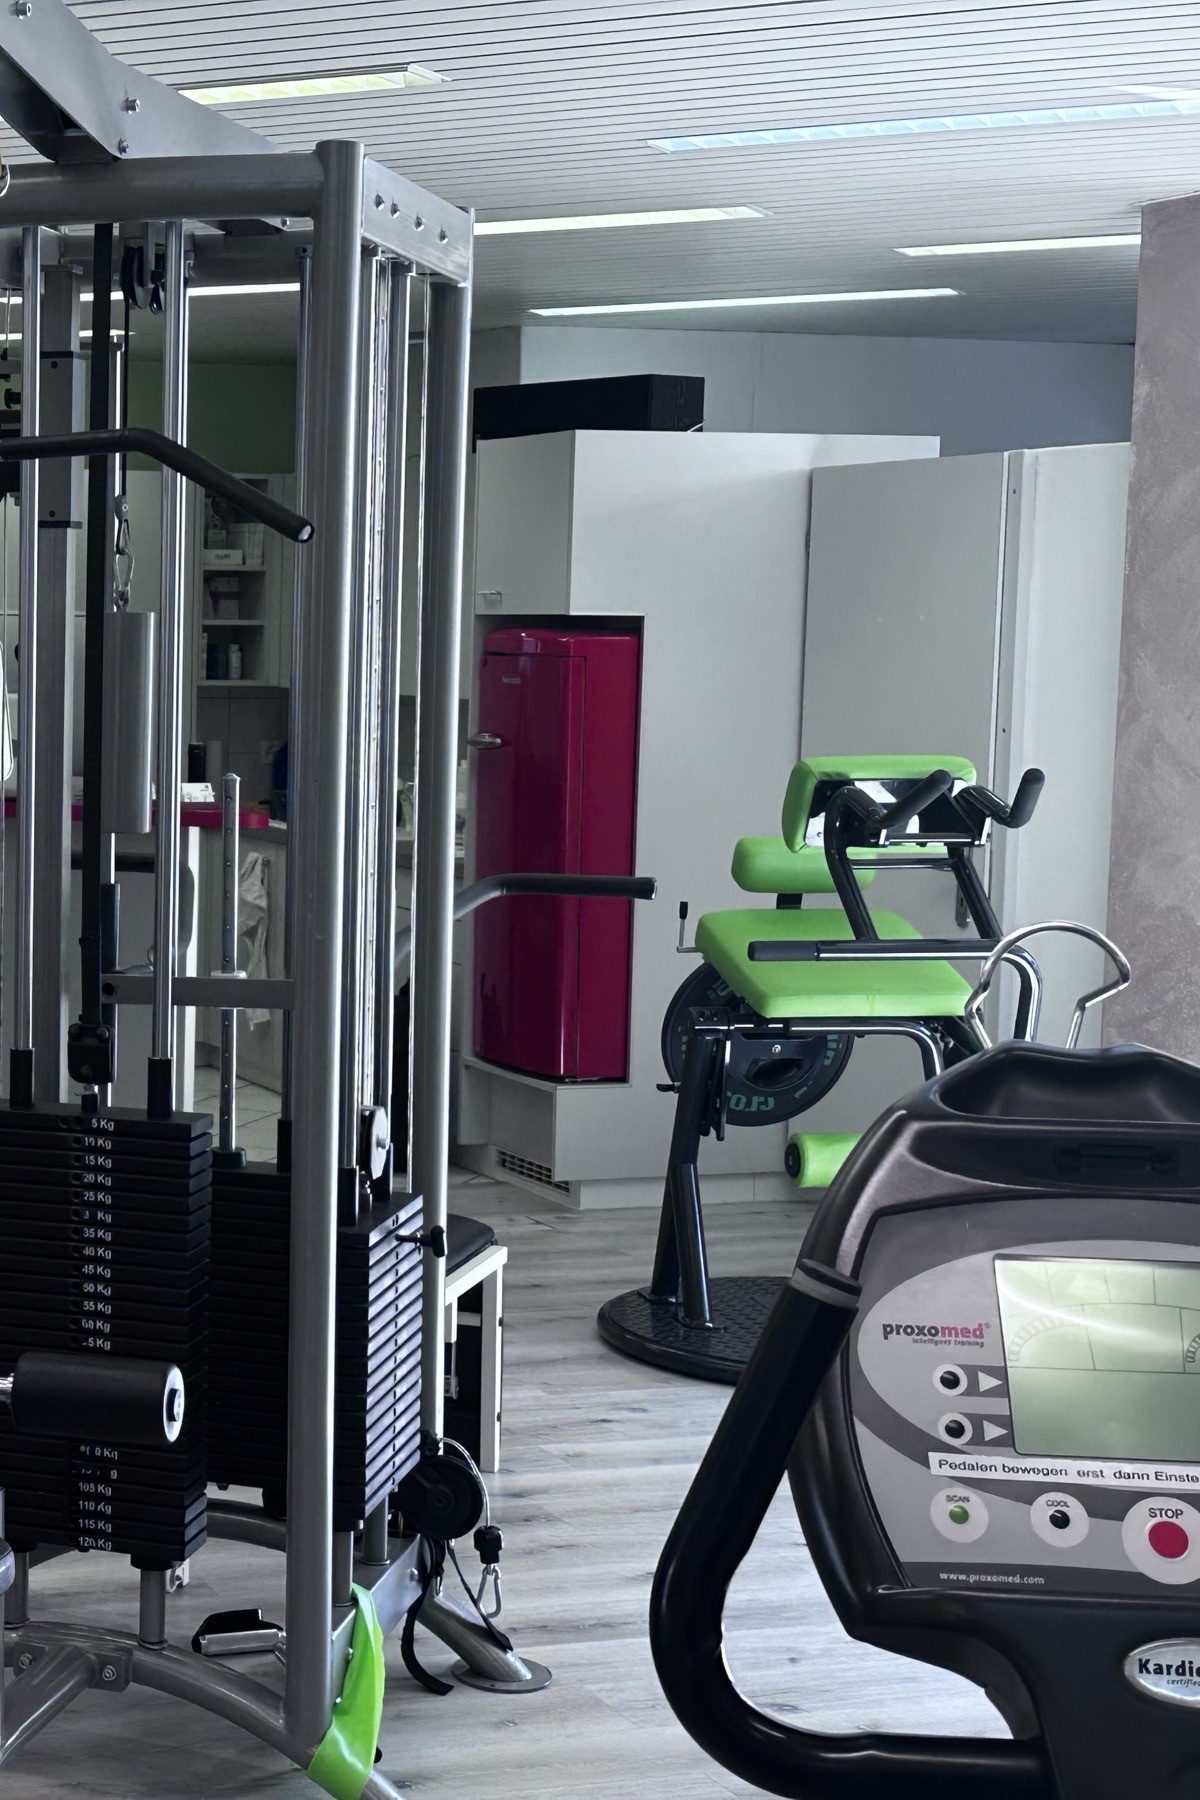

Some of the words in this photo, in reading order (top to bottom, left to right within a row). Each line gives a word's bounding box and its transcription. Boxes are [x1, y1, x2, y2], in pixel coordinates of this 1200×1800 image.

[91, 1118, 98, 1128] 5
[100, 1119, 114, 1131] Kg
[97, 1137, 112, 1149] Kg
[85, 1155, 95, 1165] 15
[97, 1156, 112, 1168] Kg
[83, 1173, 95, 1183] 20
[97, 1174, 112, 1187] Kg
[83, 1191, 95, 1201] 25
[97, 1192, 112, 1205] Kg
[83, 1210, 92, 1219] 3
[97, 1211, 112, 1223] Kg
[83, 1228, 95, 1238] 35
[97, 1229, 112, 1241] Kg
[83, 1246, 95, 1256] 40
[97, 1247, 112, 1259] Kg
[82, 1265, 95, 1274] 45
[96, 1265, 111, 1278] Kg
[82, 1301, 95, 1310] 55
[97, 1302, 112, 1314] Kg
[96, 1320, 111, 1333] Kg
[82, 1338, 94, 1347] 5
[96, 1338, 111, 1351] Kg
[1113, 1470, 1150, 1481] dann
[1154, 1471, 1200, 1483] Einste
[78, 1482, 95, 1492] 105
[97, 1484, 112, 1496] Kg
[946, 1494, 970, 1503] SCAN
[1045, 1499, 1070, 1508] COOL
[78, 1501, 95, 1510] 110
[97, 1502, 112, 1515] Kg
[1148, 1507, 1184, 1519] STOP
[78, 1519, 95, 1529] 115
[97, 1520, 112, 1533] Kg
[97, 1538, 112, 1551] Kg
[939, 1572, 1045, 1584] www.proxomed.com
